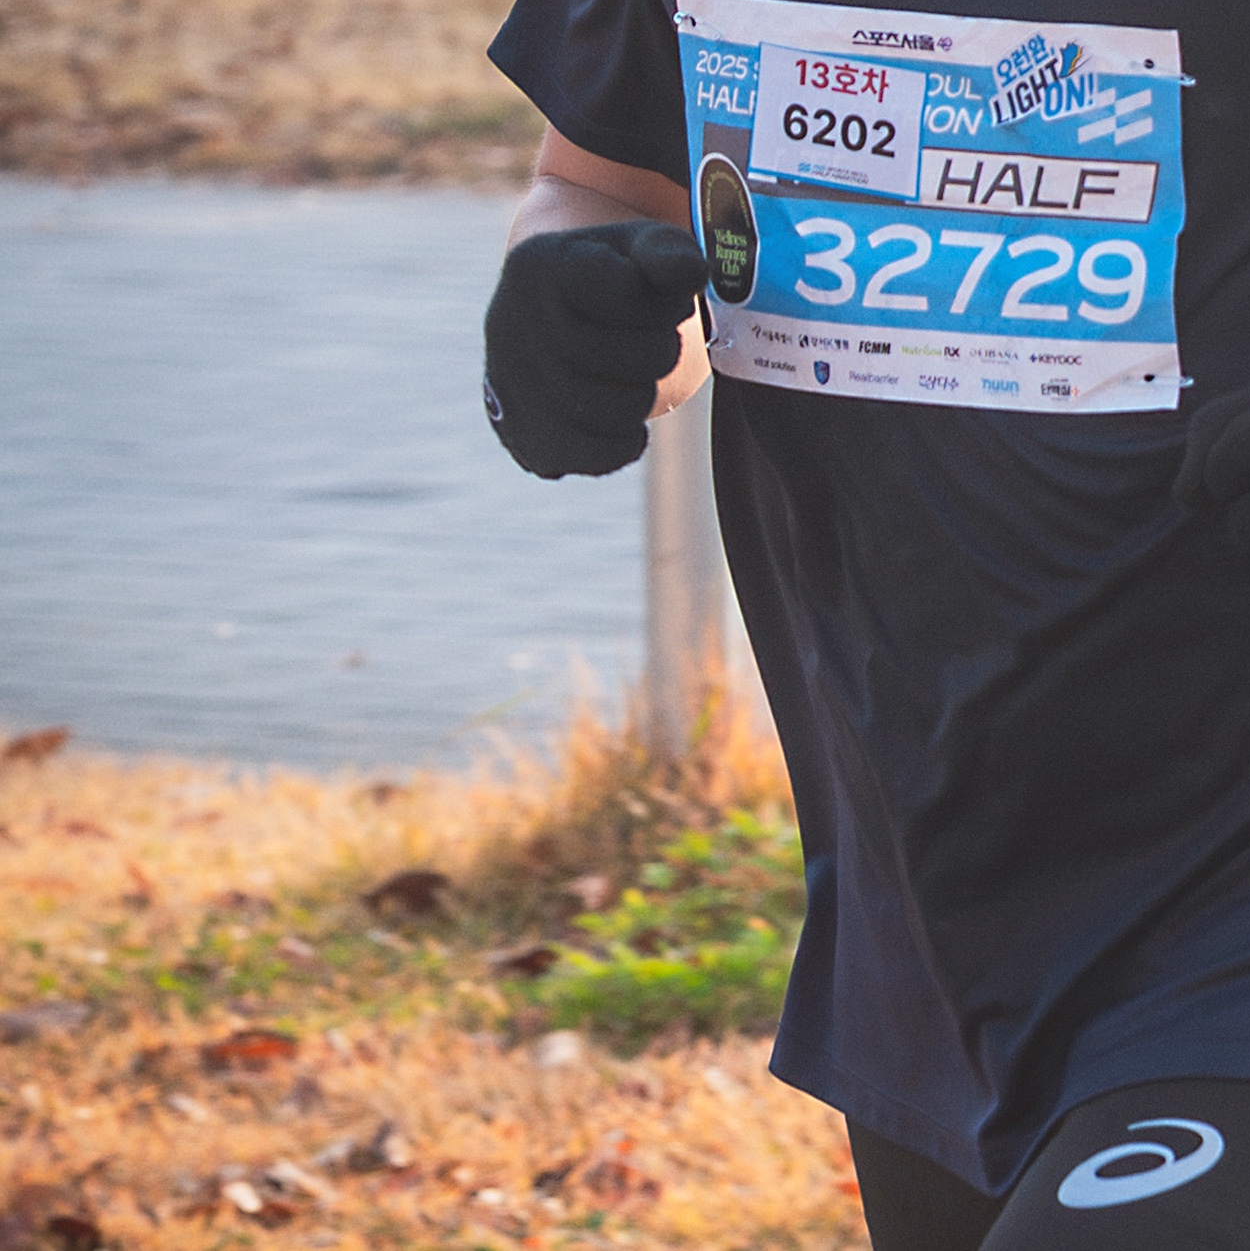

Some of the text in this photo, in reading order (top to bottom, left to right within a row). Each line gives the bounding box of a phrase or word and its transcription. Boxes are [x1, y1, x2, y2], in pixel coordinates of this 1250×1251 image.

[852, 30, 934, 51] 스포츠서울
[695, 50, 749, 80] 2025
[795, 59, 889, 103] 13호차
[993, 58, 1058, 124] LIGHT
[1044, 73, 1094, 118] ON!
[783, 103, 896, 158] 6202
[936, 158, 1120, 210] HALF
[795, 217, 1147, 325] 32729
[858, 340, 891, 355] FCMM
[981, 378, 1020, 395] nuun
